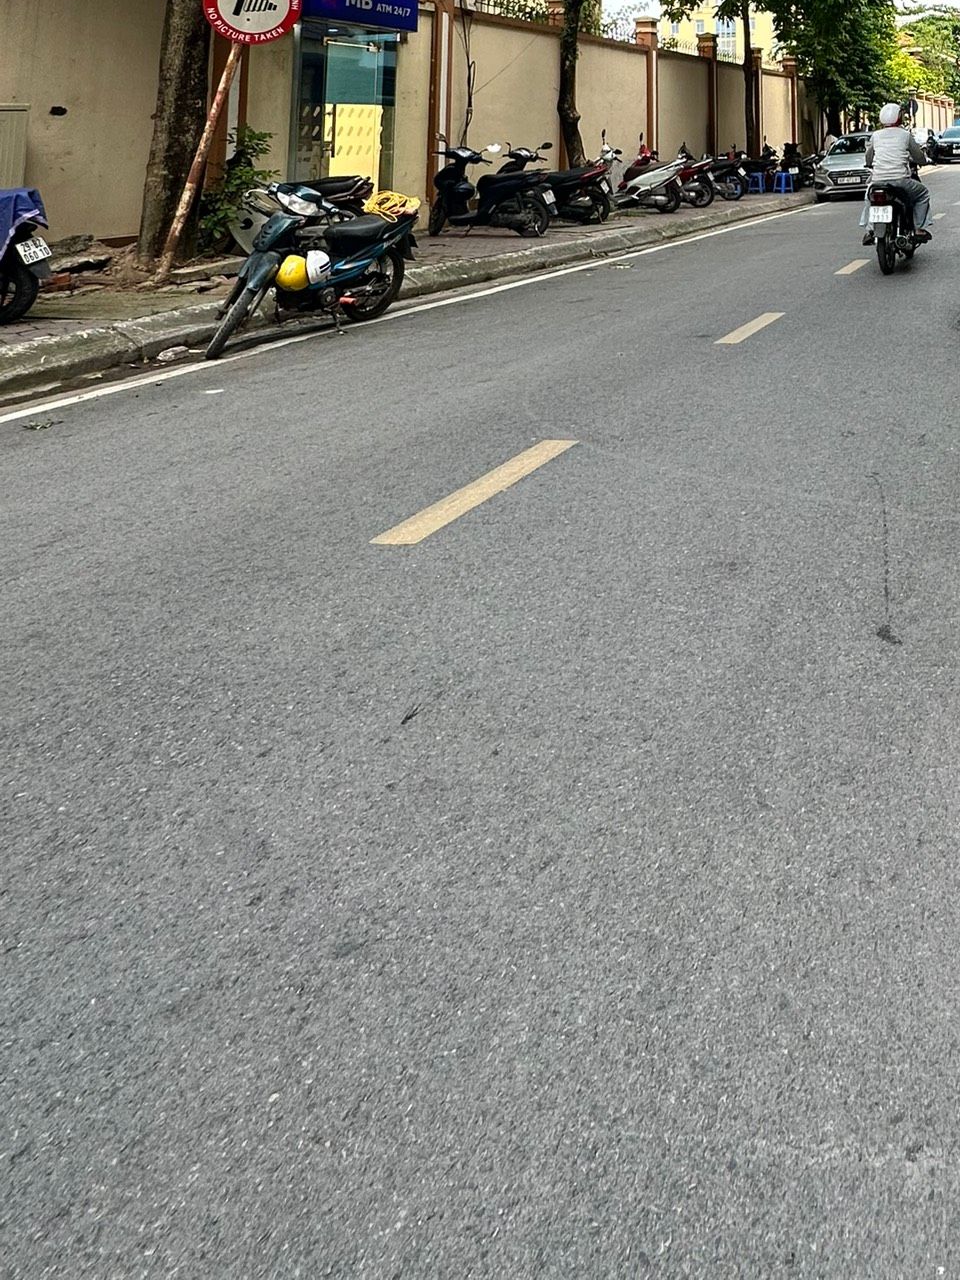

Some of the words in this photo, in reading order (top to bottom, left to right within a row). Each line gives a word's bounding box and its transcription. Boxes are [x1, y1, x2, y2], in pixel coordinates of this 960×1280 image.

[375, 2, 394, 15] ATM
[392, 5, 412, 18] 24/7
[207, 7, 218, 21] NO
[213, 20, 252, 43] PICTURE
[253, 26, 285, 42] TAKEN
